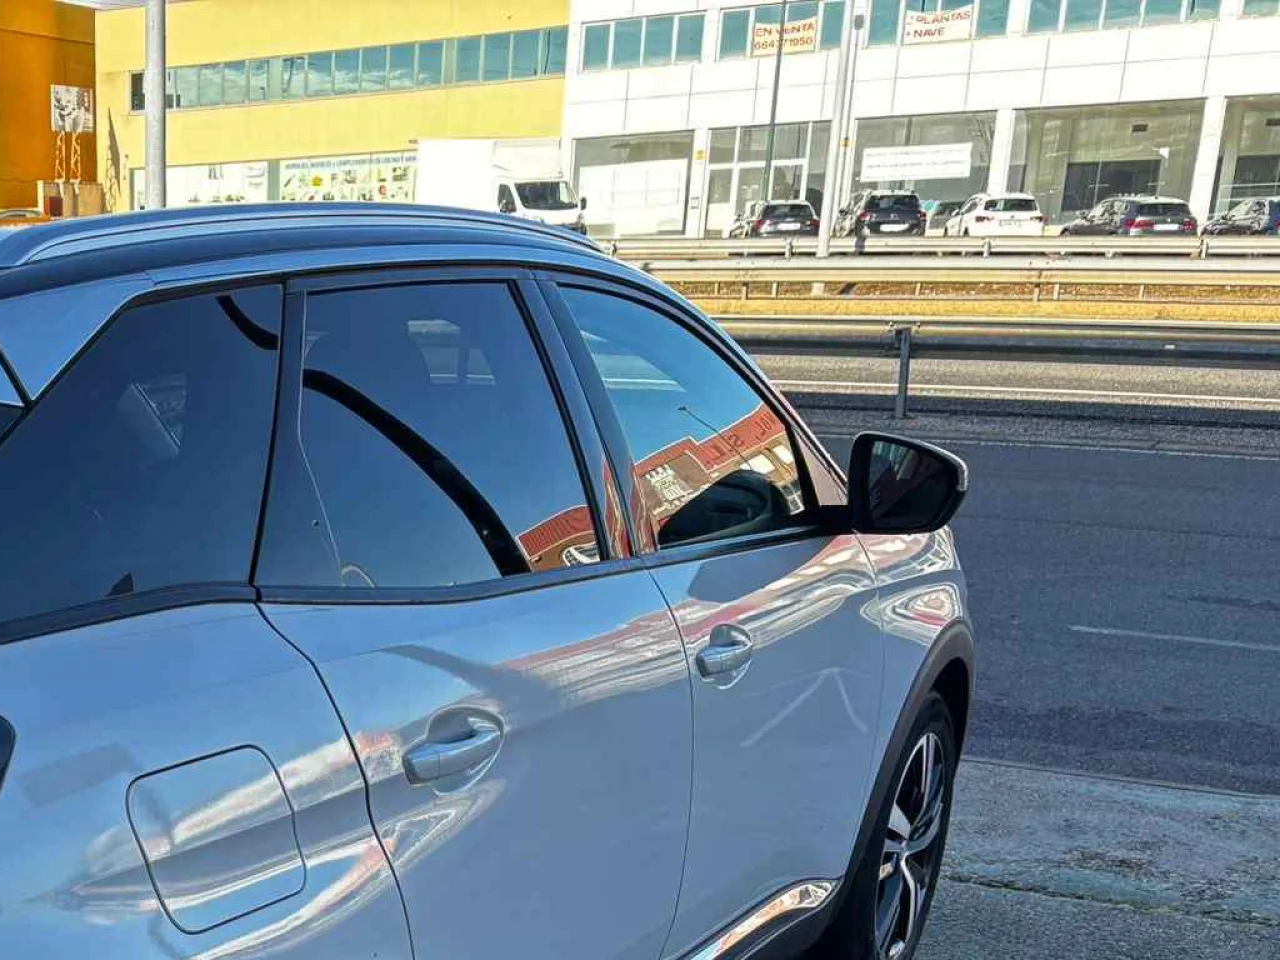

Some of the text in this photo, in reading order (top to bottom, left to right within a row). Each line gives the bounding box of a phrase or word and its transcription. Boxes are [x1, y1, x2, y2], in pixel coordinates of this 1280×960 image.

[916, 10, 971, 24] PLANTAS
[754, 28, 772, 37] EN
[913, 27, 945, 37] NAVE
